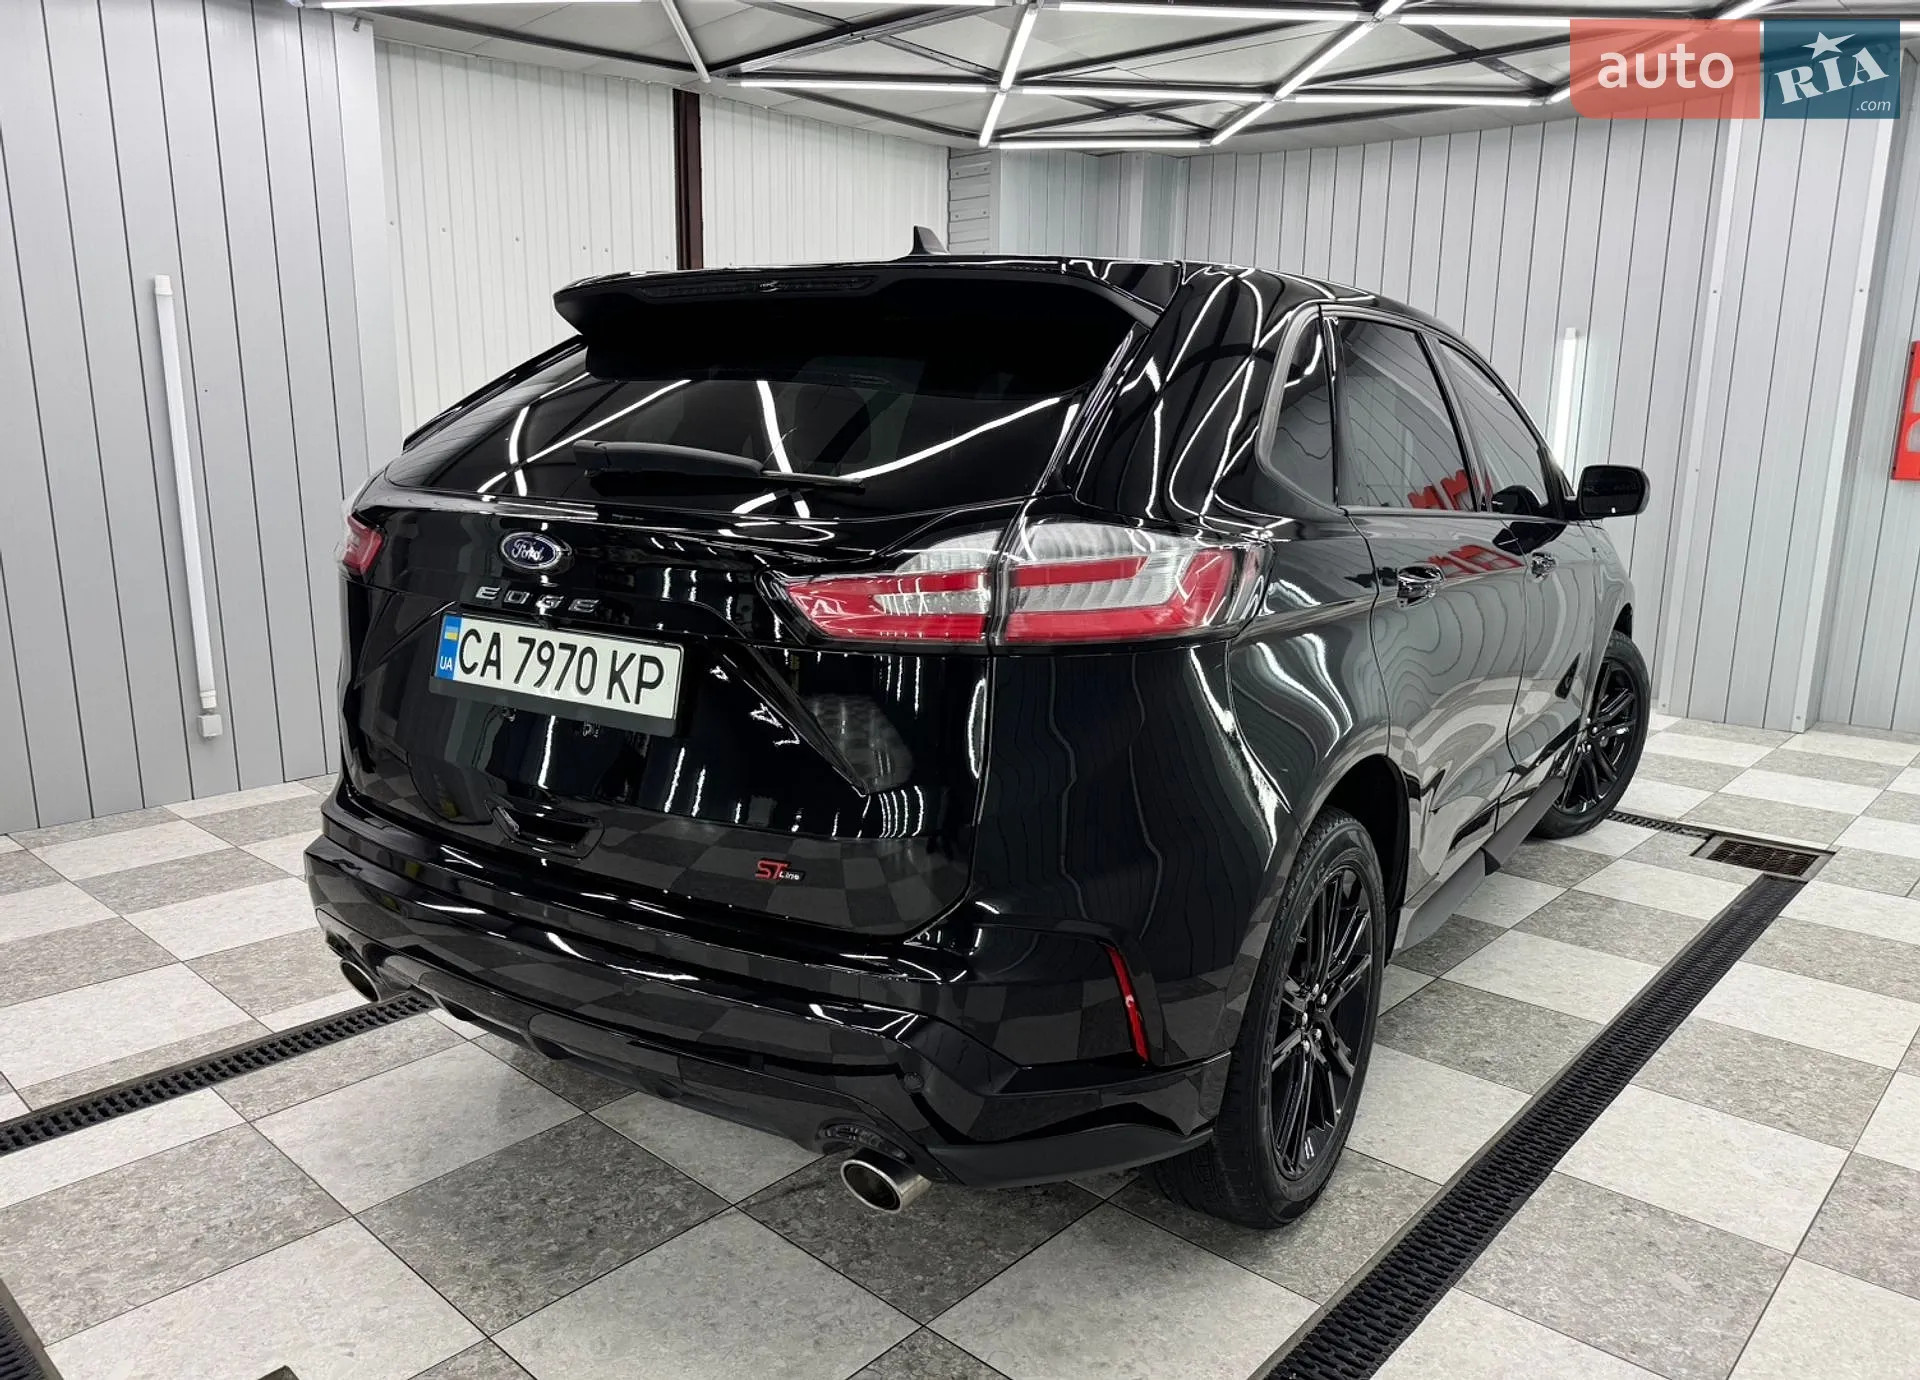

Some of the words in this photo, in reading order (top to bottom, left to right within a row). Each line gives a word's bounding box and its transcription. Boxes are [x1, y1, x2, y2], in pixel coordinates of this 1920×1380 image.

[511, 539, 545, 561] Ford
[475, 586, 599, 613] EDGE
[440, 655, 453, 671] UA
[459, 628, 502, 680] CA
[513, 636, 597, 696] 7970
[606, 650, 665, 705] KP
[755, 860, 789, 879] ST
